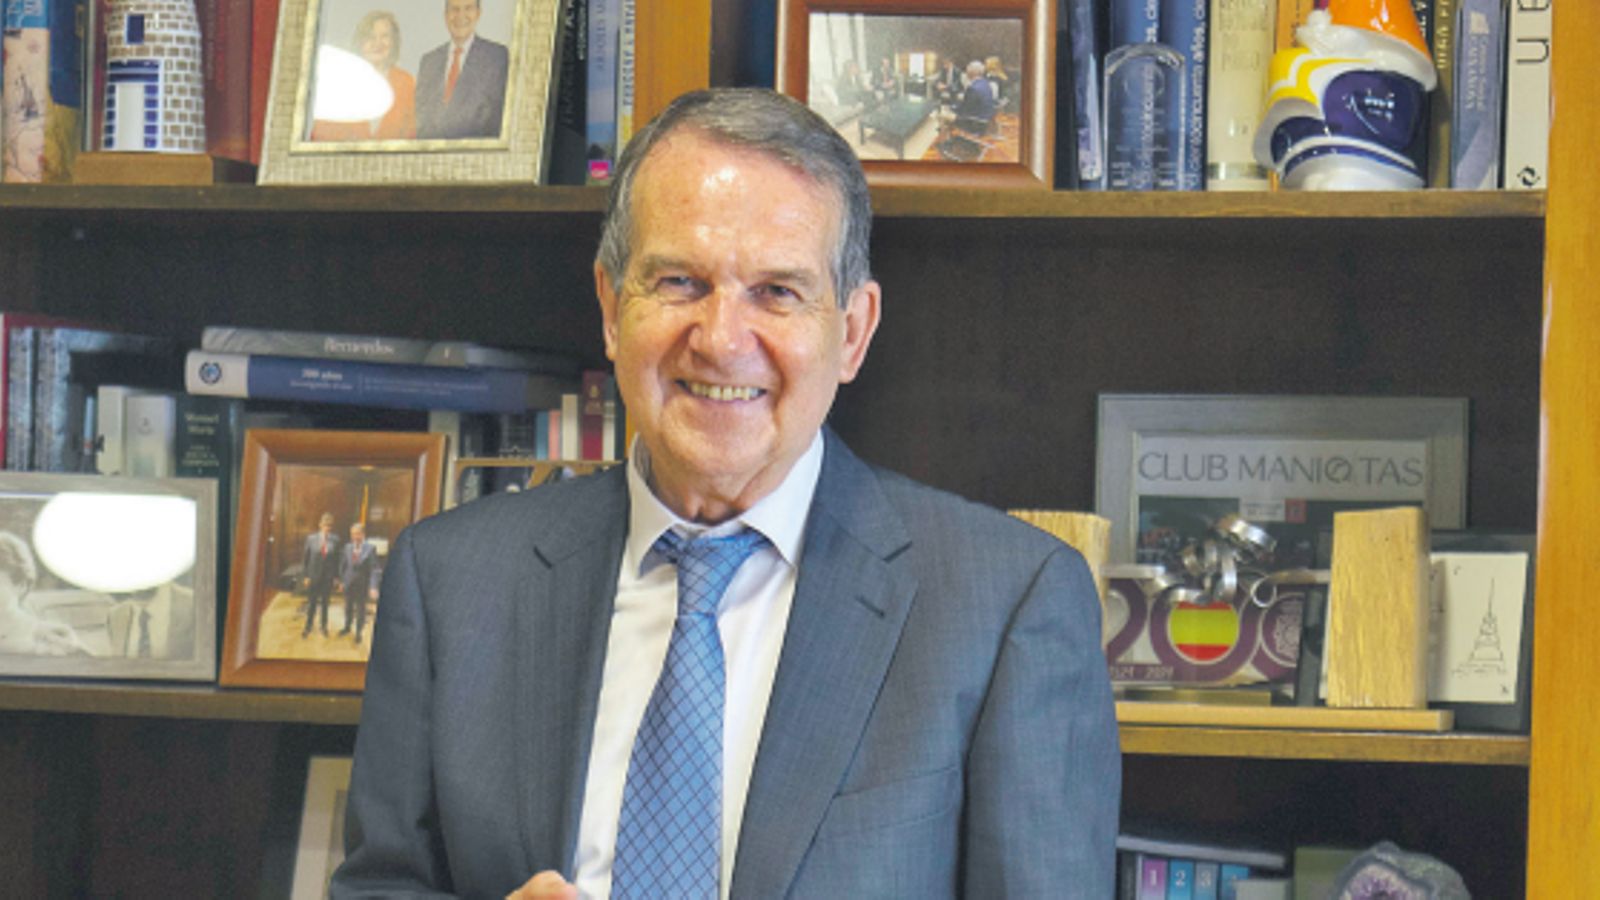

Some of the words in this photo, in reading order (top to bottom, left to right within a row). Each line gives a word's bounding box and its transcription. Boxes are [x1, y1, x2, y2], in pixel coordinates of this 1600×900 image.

[1138, 451, 1228, 481] CLUB
[1149, 869, 1158, 886] 1
[1175, 869, 1186, 887] 2
